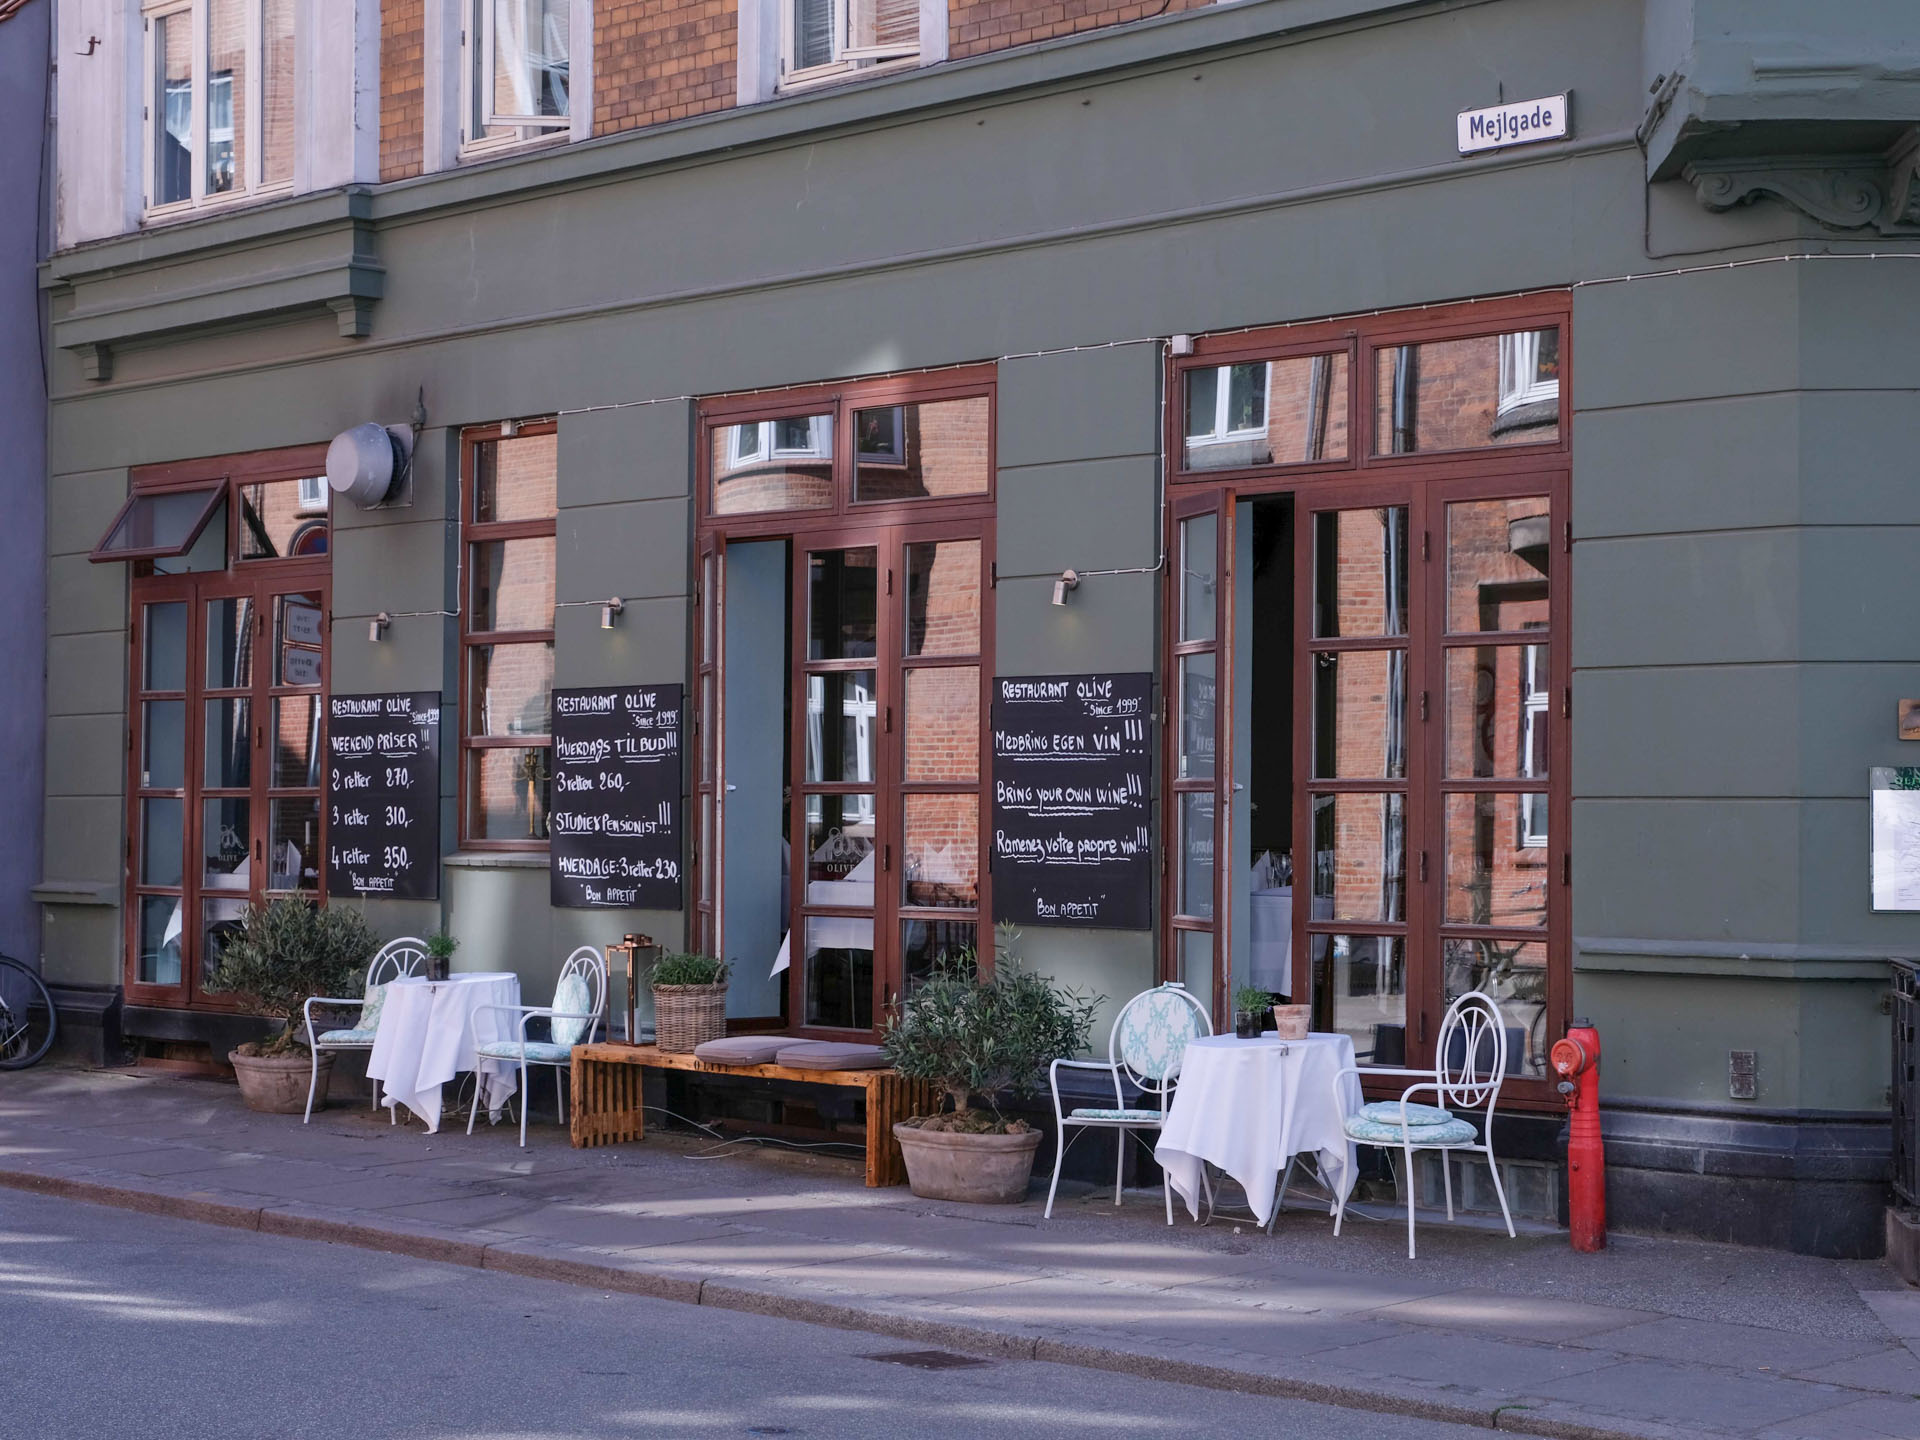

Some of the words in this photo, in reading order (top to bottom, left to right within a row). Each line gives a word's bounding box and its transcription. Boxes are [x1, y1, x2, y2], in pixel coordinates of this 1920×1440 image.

[1470, 105, 1552, 141] Mejlgade
[1002, 680, 1069, 699] RESTAURANT
[1076, 676, 1113, 698] OLIVE
[332, 698, 382, 715] RESTAURANT
[386, 695, 411, 712] OLIVE
[557, 694, 618, 712] RESTAURANT
[625, 689, 657, 708] OLIVE
[331, 735, 375, 752] WEEKEND
[1053, 734, 1085, 751] EGEN
[332, 768, 340, 791] 2
[344, 772, 371, 789] retter
[996, 780, 1033, 803] BRING
[1065, 787, 1092, 802] OWN
[332, 805, 339, 826] 3
[344, 809, 369, 826] retter
[331, 846, 339, 870] 4
[343, 849, 370, 865] retter
[996, 830, 1046, 863] Ramenez
[1045, 831, 1074, 854] votre
